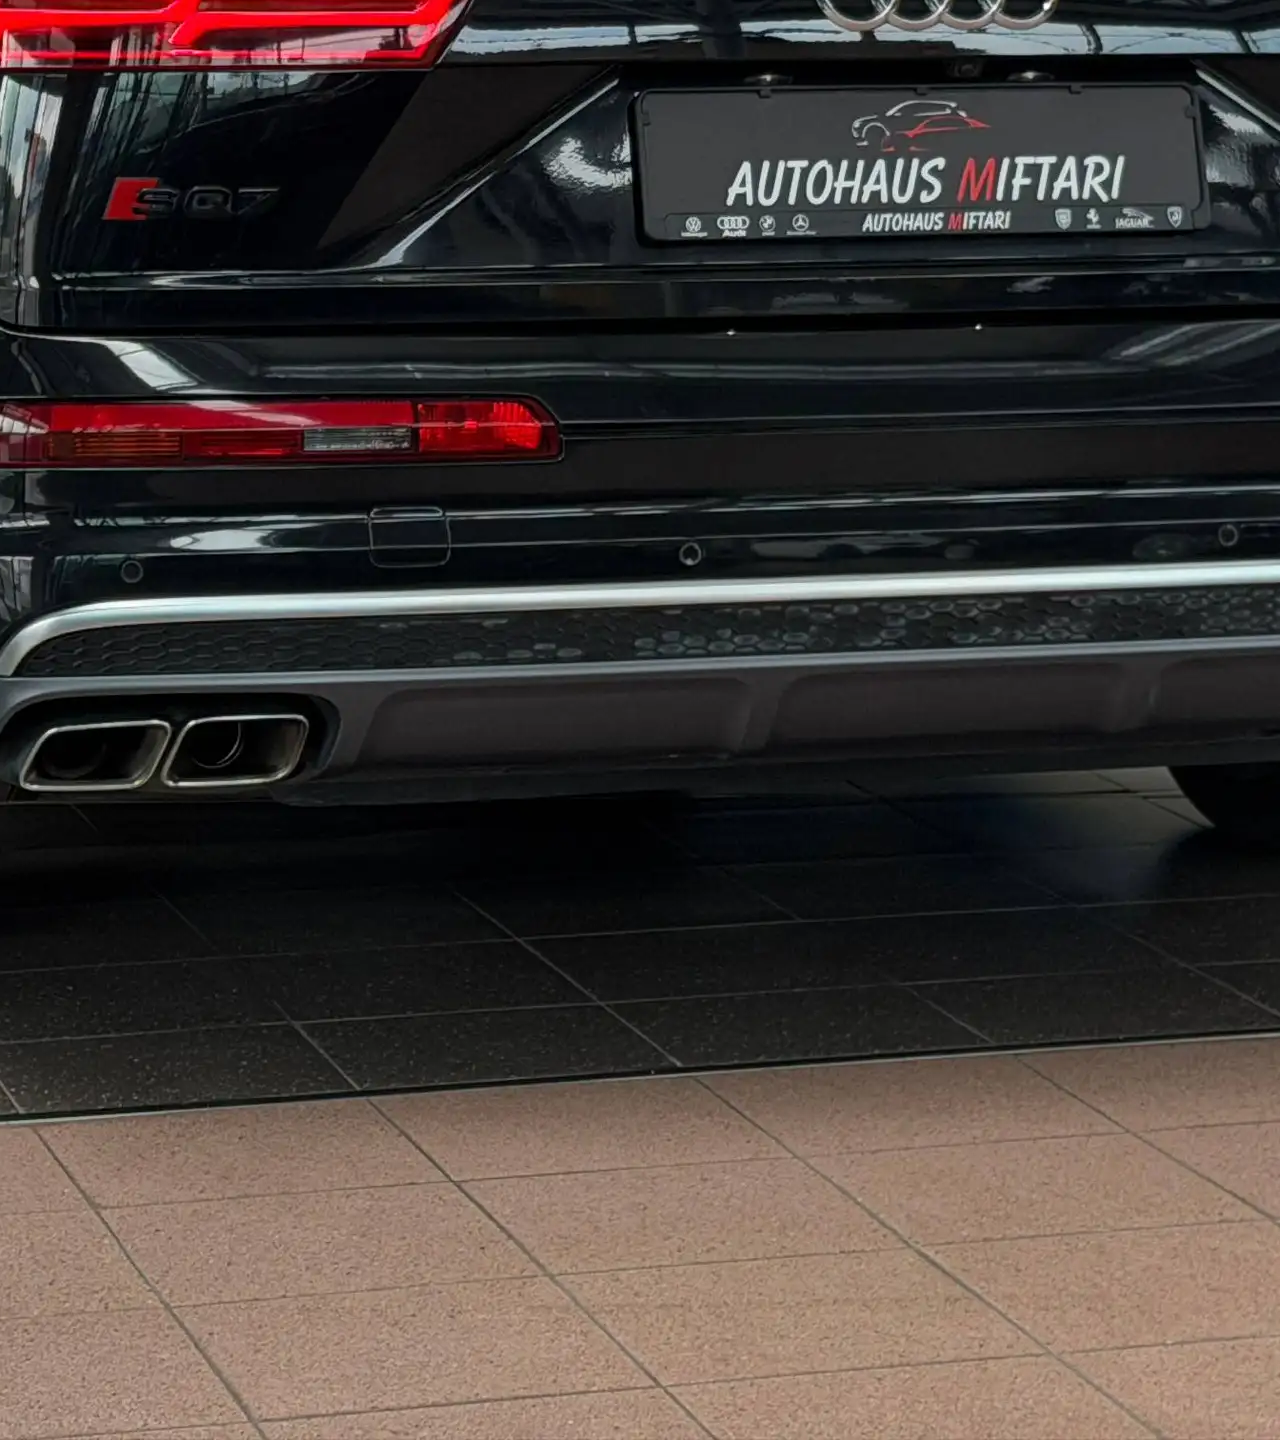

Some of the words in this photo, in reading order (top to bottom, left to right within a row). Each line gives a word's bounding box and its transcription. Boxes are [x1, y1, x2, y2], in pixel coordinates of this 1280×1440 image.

[725, 158, 946, 207] AUTOHAUS
[956, 154, 1126, 203] MIFTARI
[132, 184, 281, 220] SQ7
[861, 211, 945, 233] AUTOHAUS
[947, 210, 1012, 231] MIFTARI
